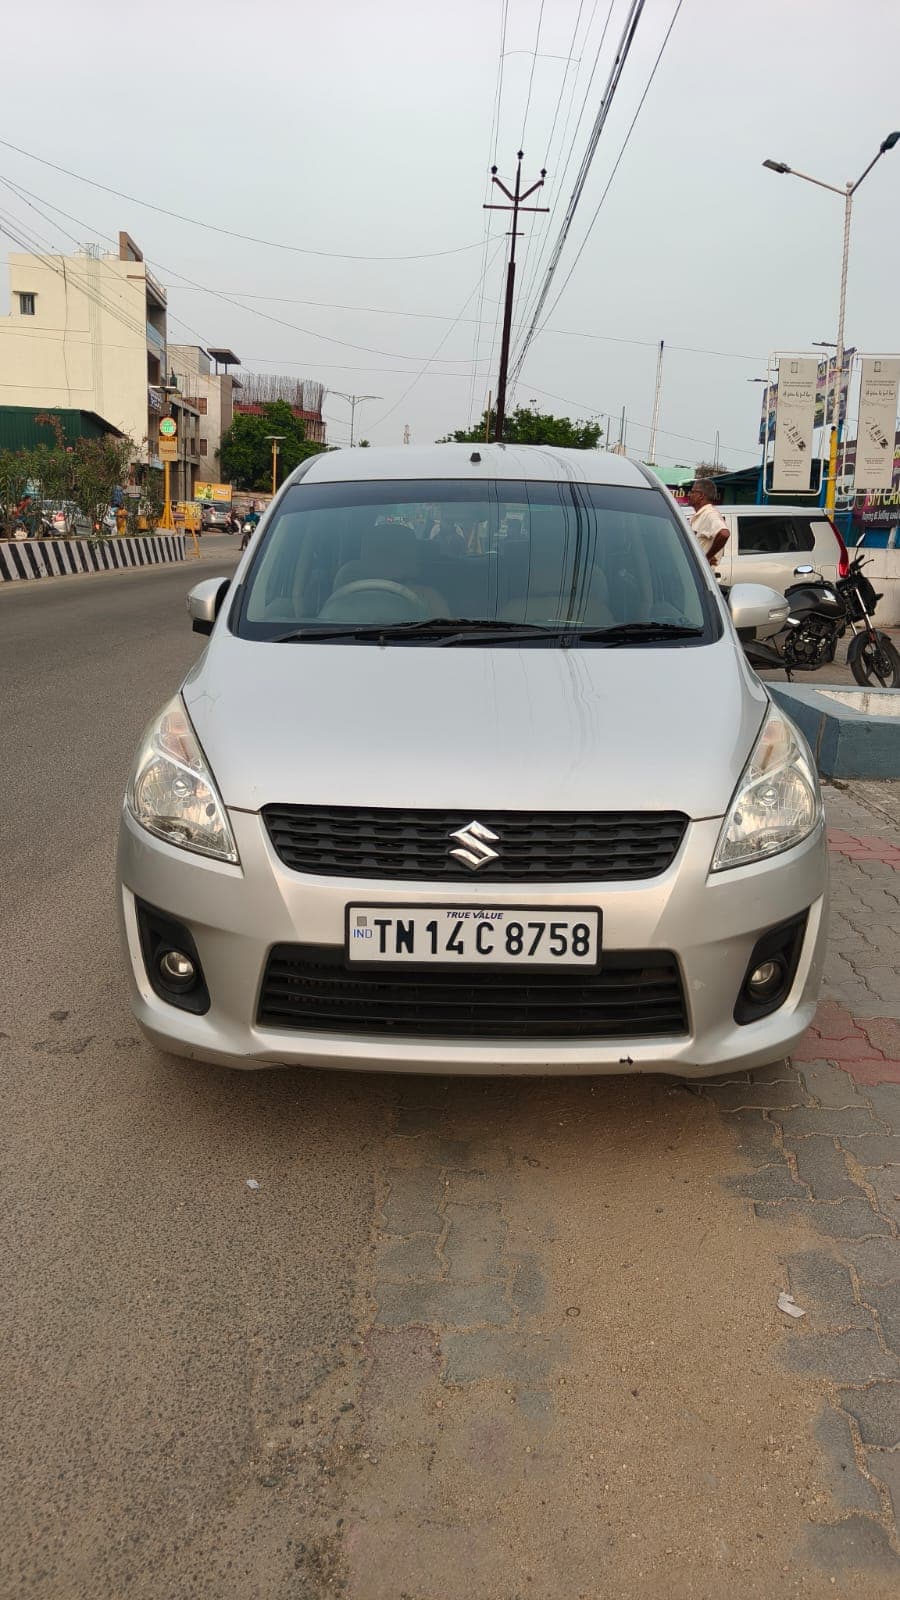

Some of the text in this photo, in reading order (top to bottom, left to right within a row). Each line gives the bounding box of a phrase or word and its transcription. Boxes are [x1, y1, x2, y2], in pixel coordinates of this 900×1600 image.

[446, 911, 504, 920] TRUE VALUE
[353, 928, 373, 939] IND
[374, 919, 590, 957] TN 14 C 8758
